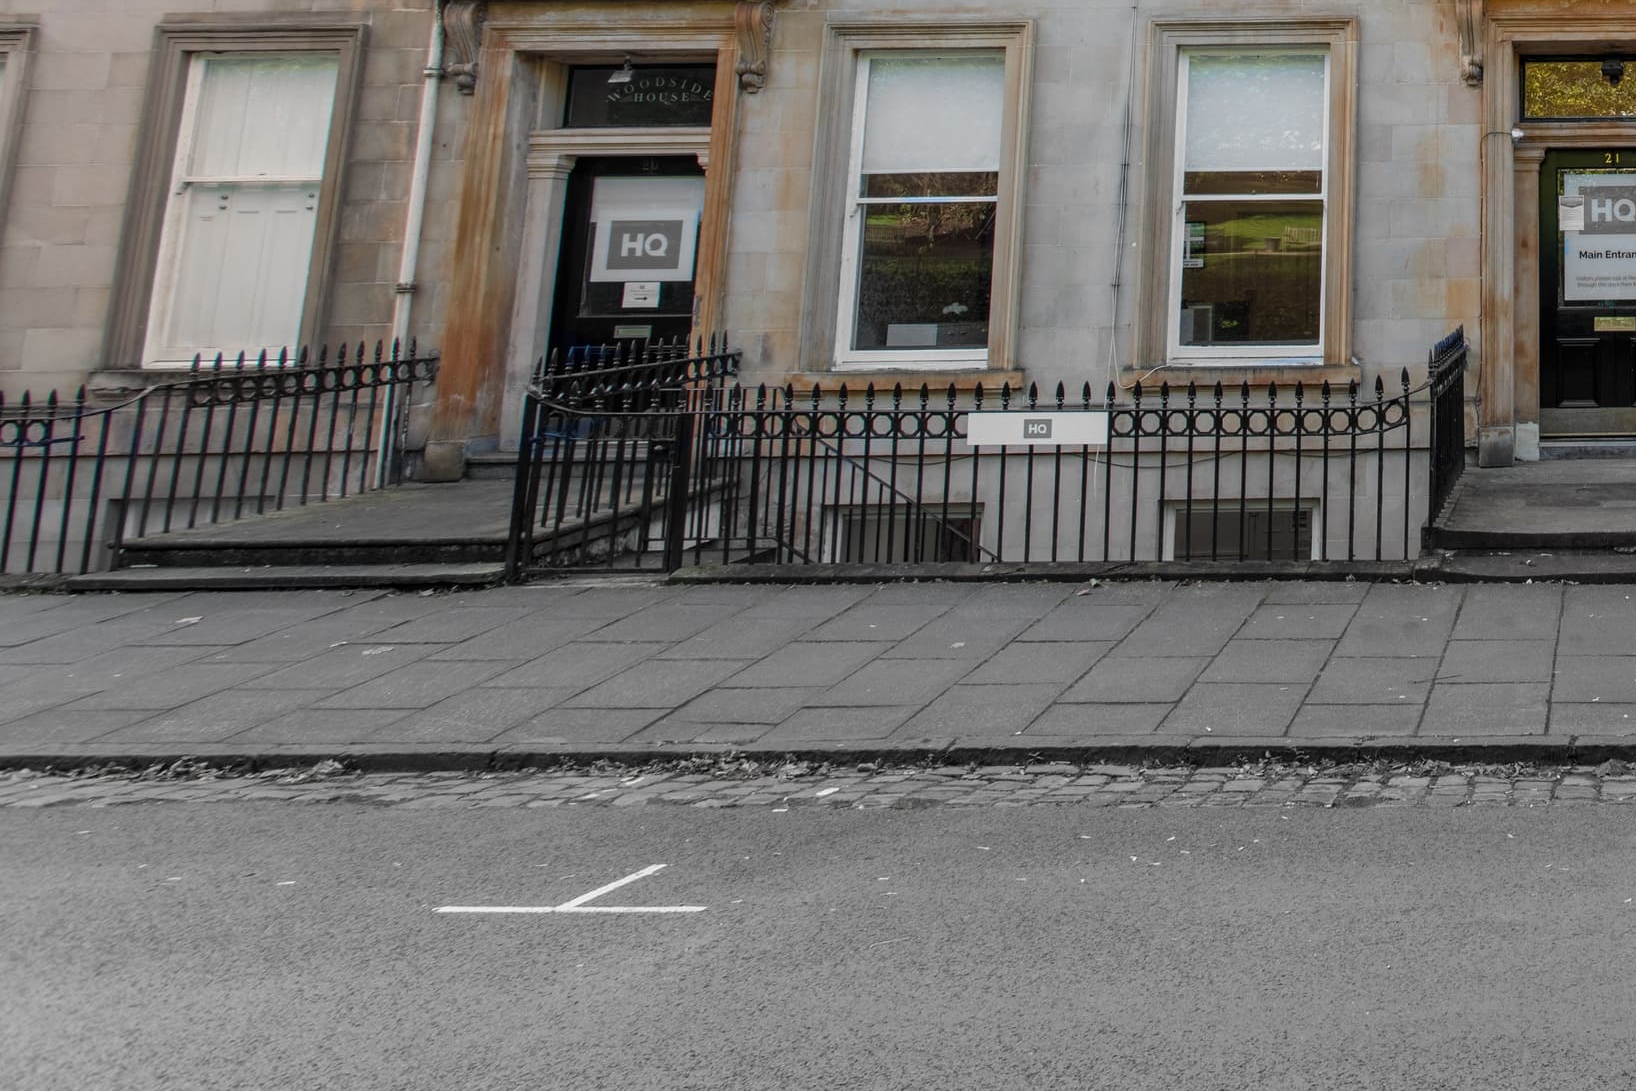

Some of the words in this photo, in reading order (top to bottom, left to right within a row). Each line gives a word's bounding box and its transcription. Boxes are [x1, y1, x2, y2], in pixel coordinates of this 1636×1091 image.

[607, 77, 713, 102] WOODSIDE
[634, 92, 690, 103] HOUSE
[1604, 152, 1620, 164] 21
[1591, 198, 1636, 223] HQ
[620, 232, 669, 257] HQ
[1578, 250, 1603, 259] Main
[1027, 423, 1048, 435] HQ
